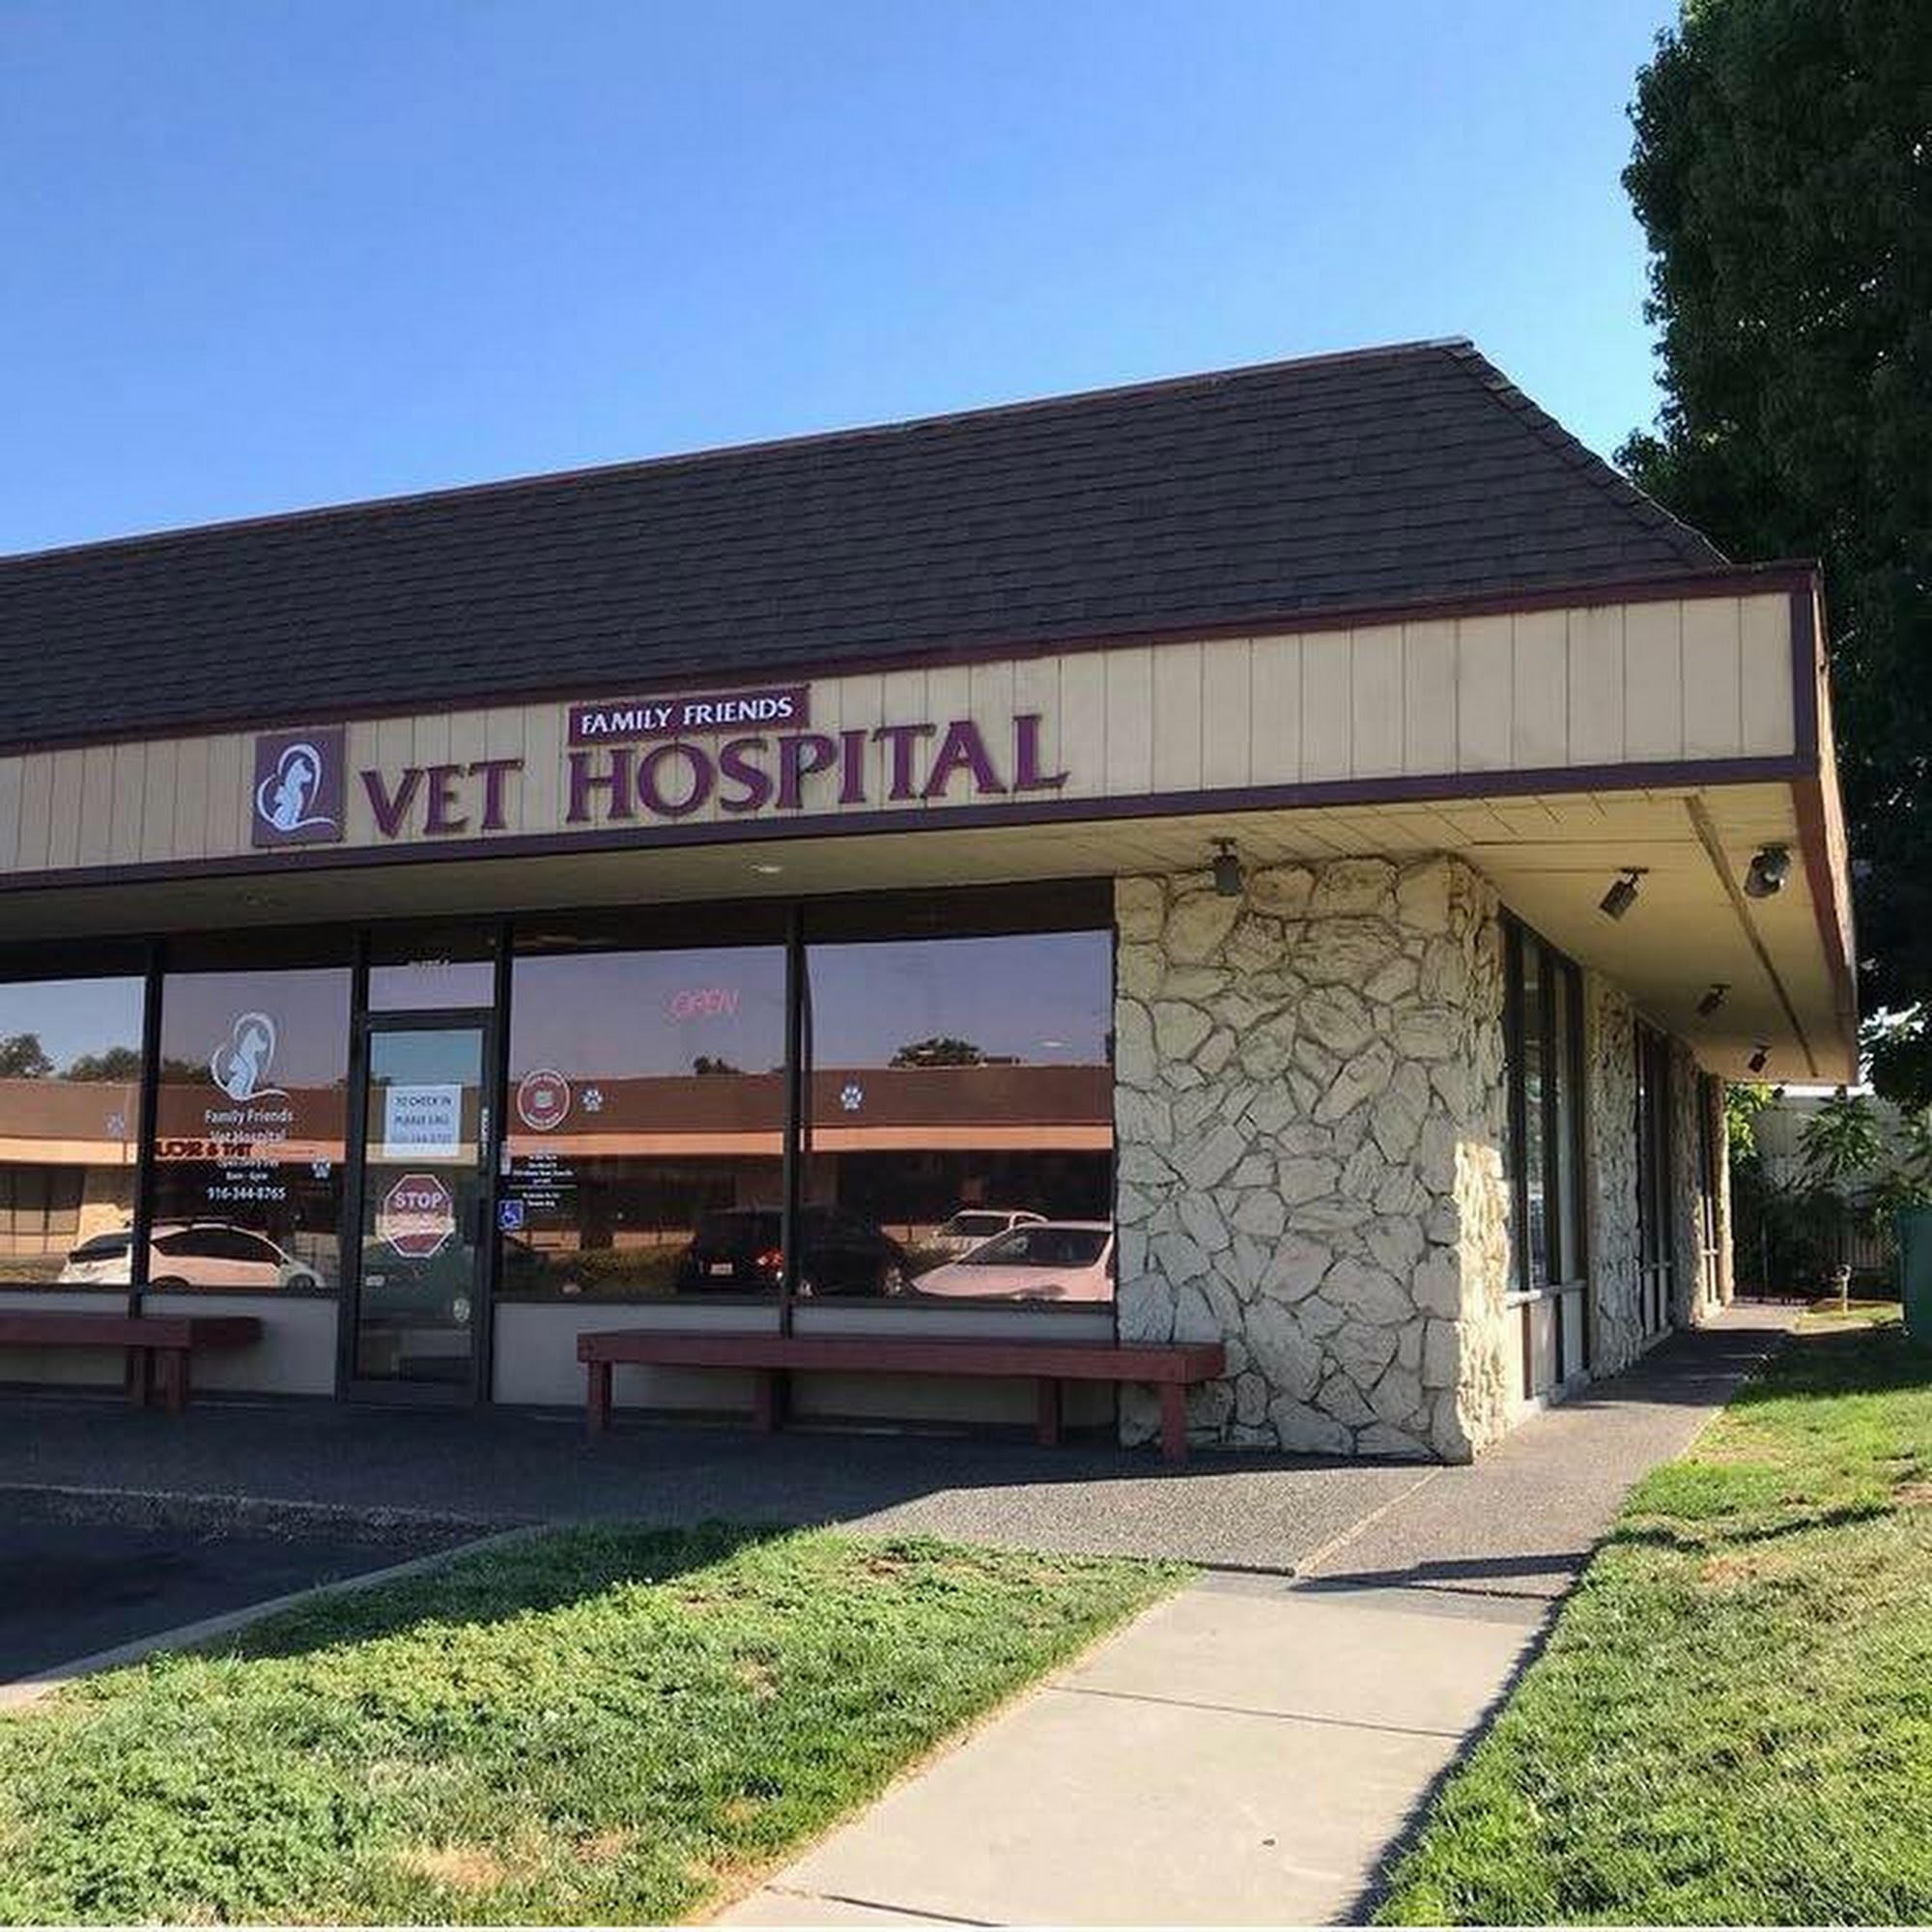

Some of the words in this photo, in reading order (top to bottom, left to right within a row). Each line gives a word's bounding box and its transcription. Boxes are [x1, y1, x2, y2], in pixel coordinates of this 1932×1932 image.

[582, 706, 673, 734] FAMILY
[682, 696, 793, 725] FRIENDS
[359, 758, 526, 839] VET
[566, 714, 1071, 824] HOSPITAL
[205, 1109, 244, 1126] Family
[247, 1108, 293, 1122] Friends
[394, 1191, 443, 1209] STOP
